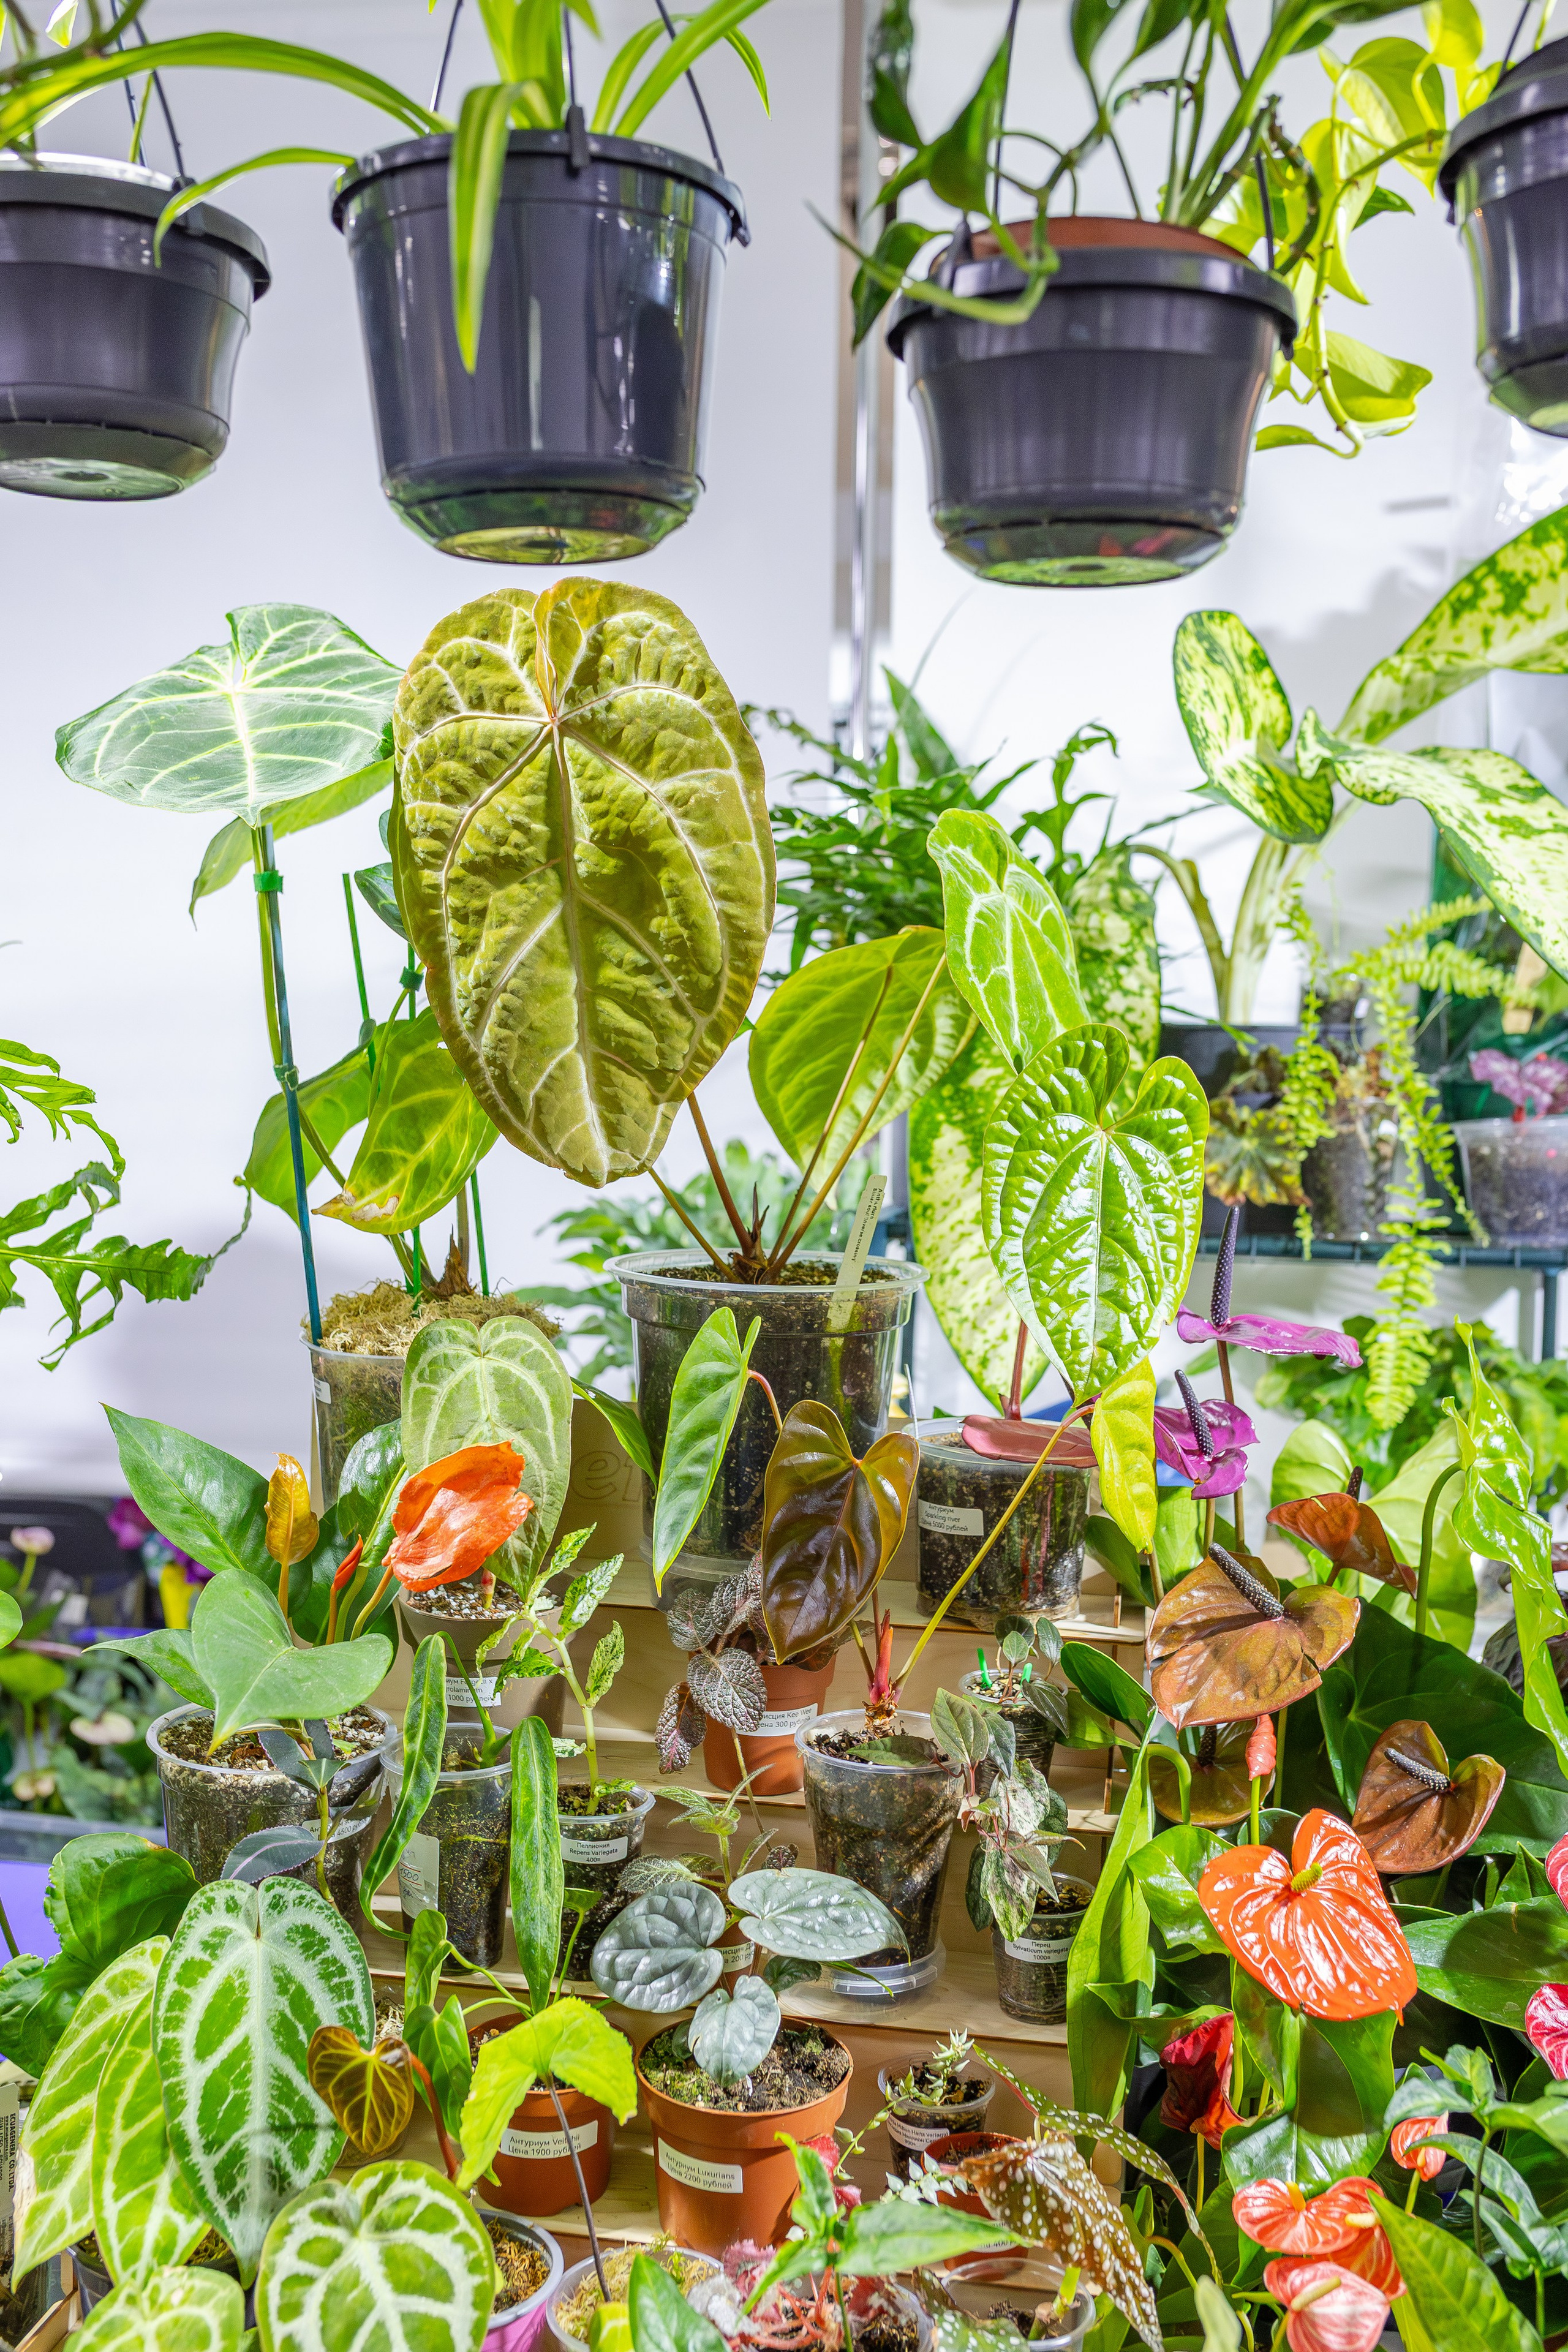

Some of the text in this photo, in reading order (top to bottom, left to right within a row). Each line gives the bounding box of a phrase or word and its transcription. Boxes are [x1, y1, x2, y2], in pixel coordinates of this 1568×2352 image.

[466, 1693, 492, 1703] рулей
[570, 1847, 590, 1856] Repens
[400, 1869, 419, 1881] 1500
[1012, 1943, 1042, 1954] Sylvaticum
[731, 1954, 743, 1963] 200
[510, 2134, 580, 2148] Антуриум Veithii
[508, 2145, 528, 2155] Цена
[666, 2152, 735, 2180] Антуриум Luxurians
[668, 2162, 733, 2190] Цена 2200 рублей
